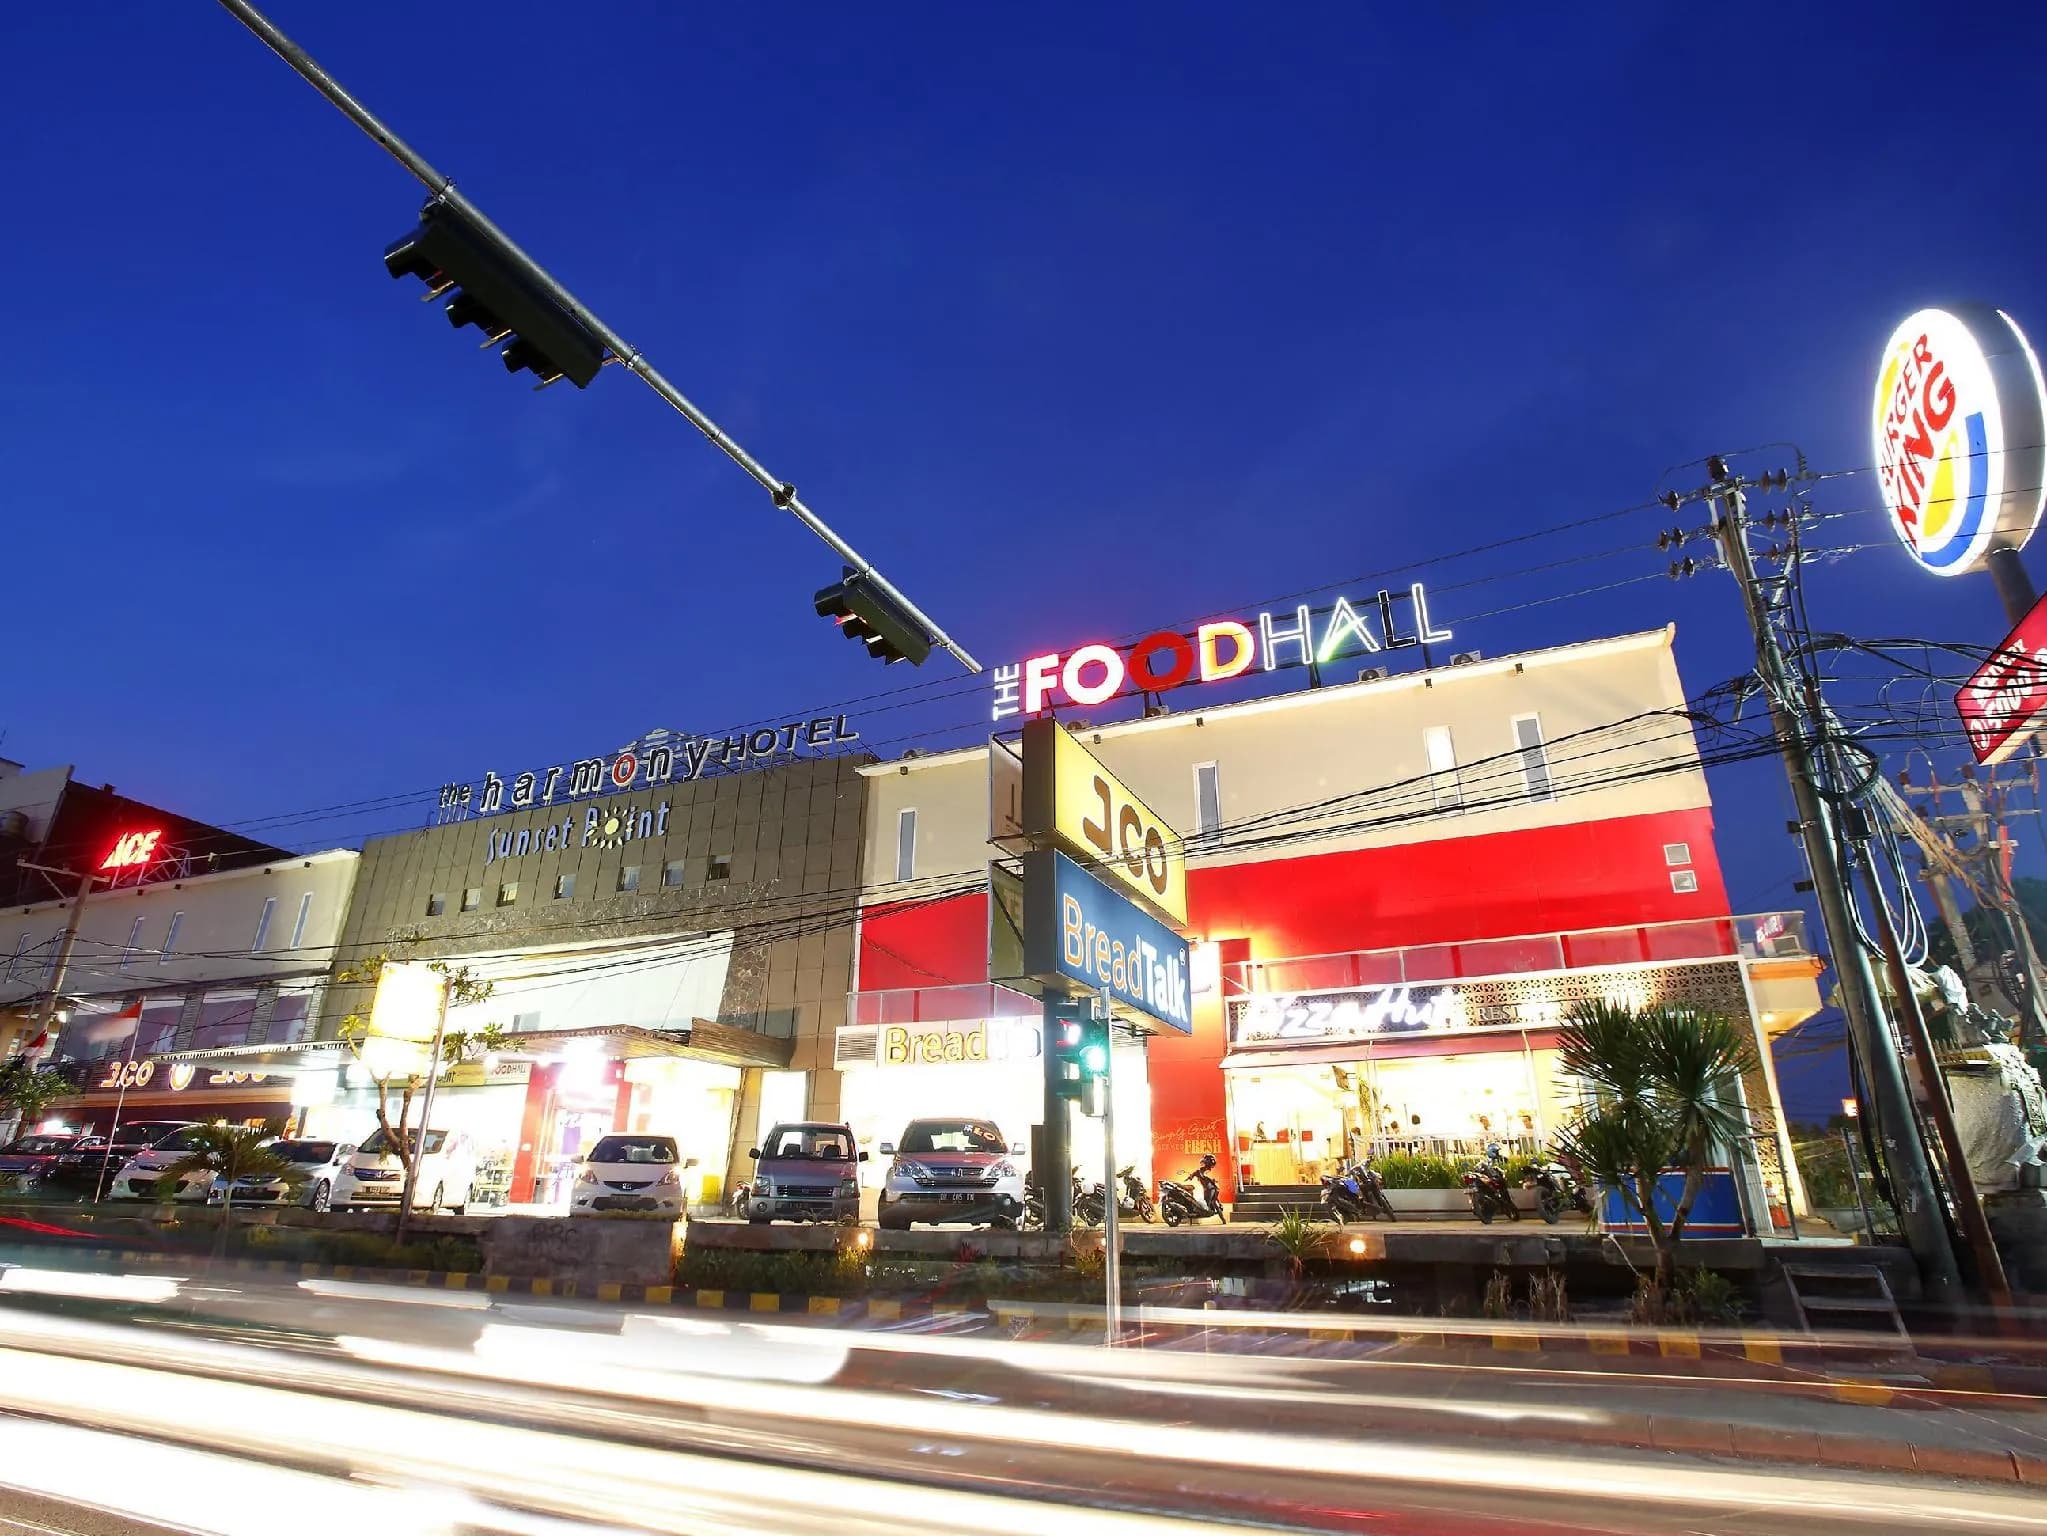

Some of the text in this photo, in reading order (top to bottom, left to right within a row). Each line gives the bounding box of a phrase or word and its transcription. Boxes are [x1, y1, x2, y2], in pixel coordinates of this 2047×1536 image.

[1896, 360, 1957, 558] KING
[992, 662, 1021, 721] THE
[438, 714, 860, 813] the harmony HOTEL
[99, 829, 162, 870] ACE
[485, 814, 575, 866] Sunset
[1063, 893, 1188, 1023] BreadTalk
[1183, 1139, 1222, 1155] FRESH
